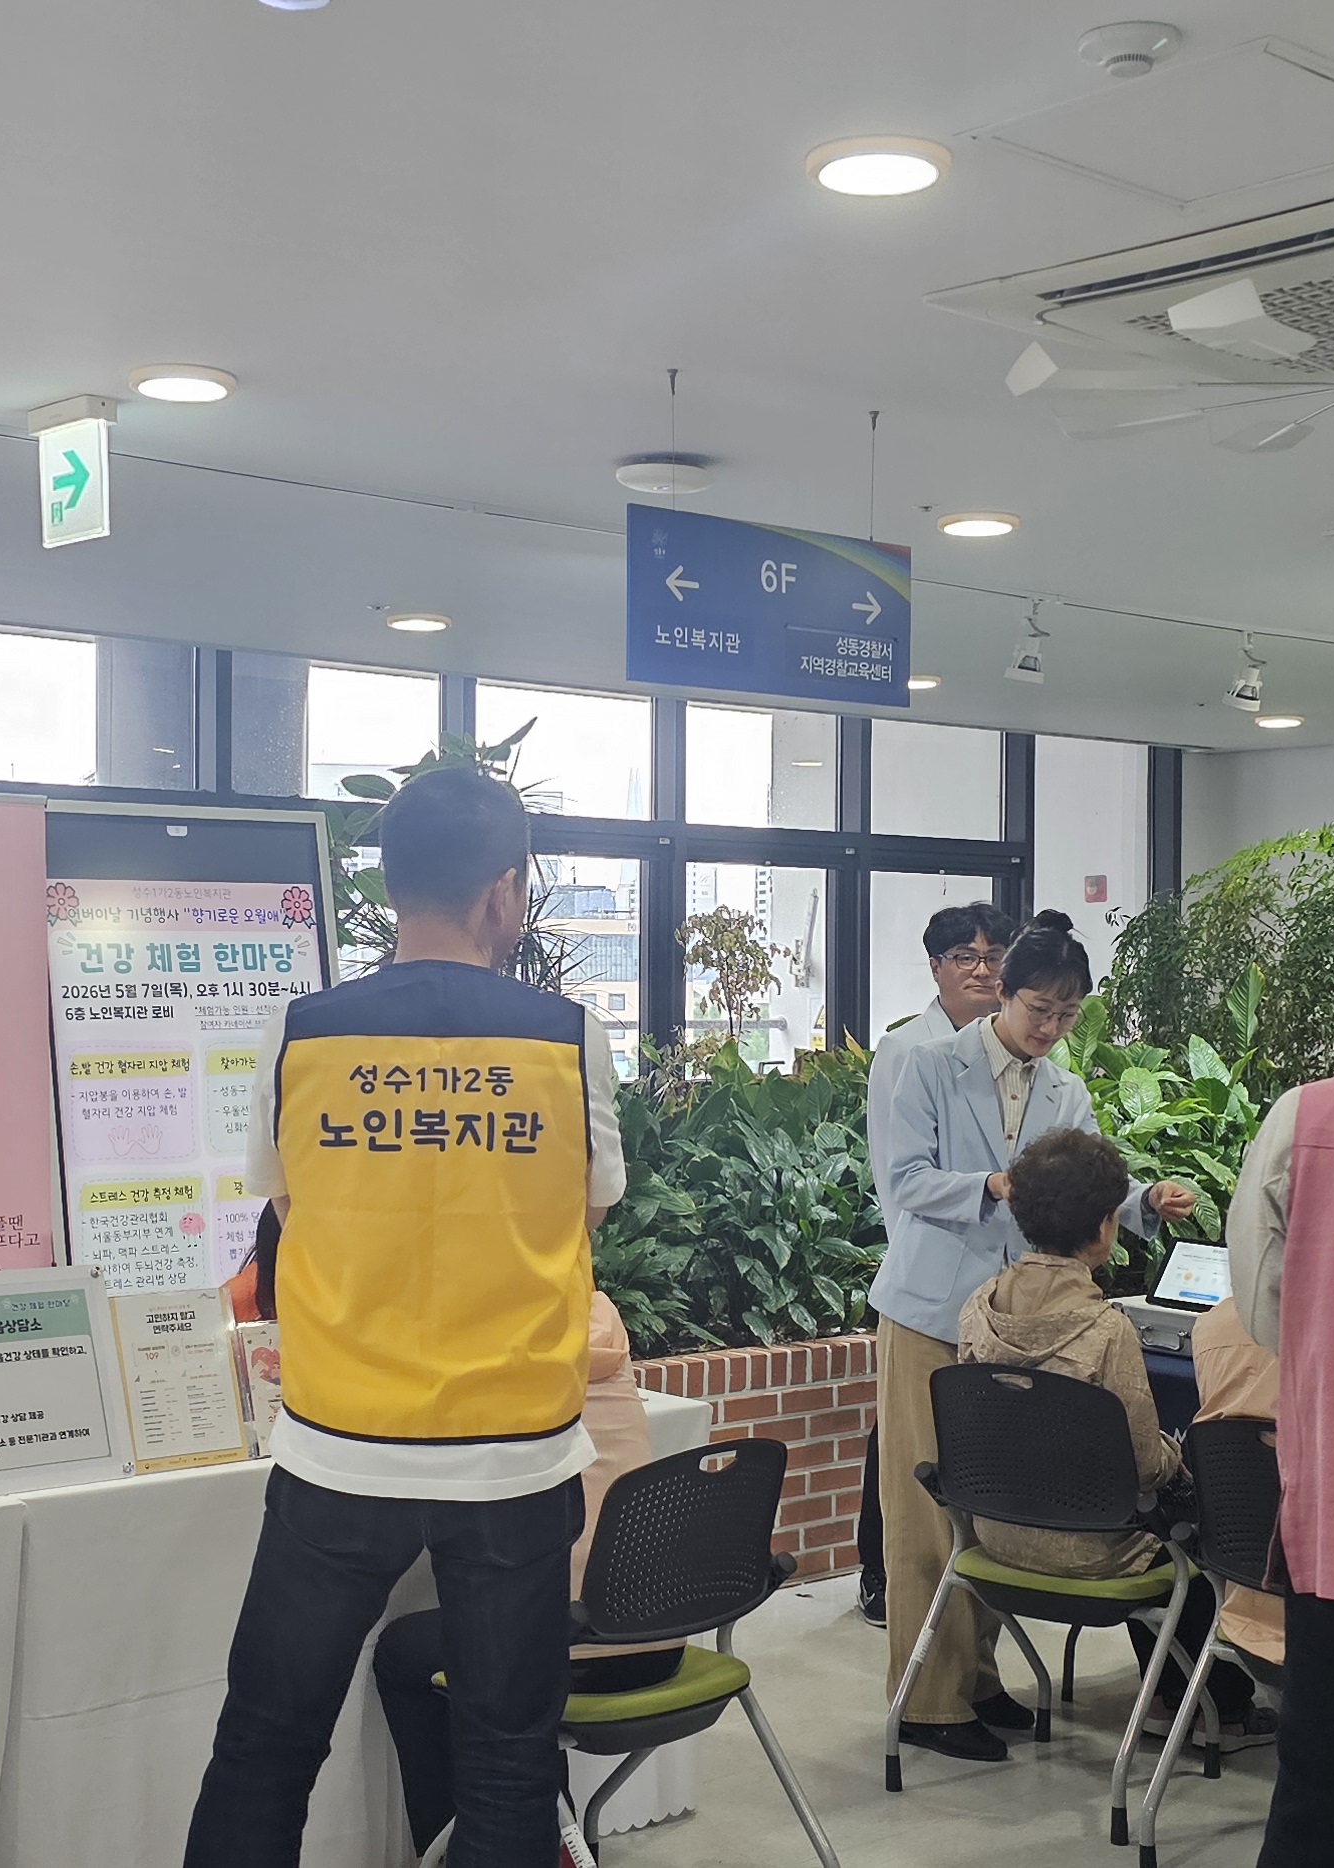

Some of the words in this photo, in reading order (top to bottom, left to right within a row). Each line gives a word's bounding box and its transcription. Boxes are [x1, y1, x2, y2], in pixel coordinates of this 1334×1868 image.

[759, 559, 798, 594] 6F
[655, 624, 741, 654] 노인복지관
[836, 636, 893, 661] 성동경찰서
[800, 655, 893, 683] 지역경찰교육센터
[133, 887, 232, 900] 성수1가2동노인복지관
[67, 907, 121, 923] 어버이날
[127, 908, 180, 925] 기념행사
[183, 908, 240, 924] "향기로운
[76, 943, 135, 974] 건강
[145, 942, 202, 973] 체험
[213, 942, 295, 973] 한마당
[61, 984, 112, 999] 2026년
[115, 984, 137, 999] 5월
[141, 982, 193, 1000] 7일(목),
[196, 983, 220, 998] 오후
[223, 981, 244, 997] 1시
[249, 981, 312, 998] 30분~4시
[65, 1006, 86, 1021] 6층
[89, 1006, 148, 1020] 노인복지관
[152, 1005, 174, 1019] 로비
[94, 1061, 114, 1074] 건강
[117, 1059, 146, 1073] 혈자리
[149, 1059, 168, 1072] 지압
[171, 1057, 191, 1072] 체험
[349, 1064, 514, 1097] 성수1가2동
[79, 1089, 118, 1103] 지압봉을
[121, 1088, 159, 1101] 이용하여
[220, 1084, 247, 1097] 성동구
[82, 1106, 111, 1120] 혈자리
[114, 1105, 134, 1118] 건강
[137, 1104, 156, 1117] 지압
[159, 1103, 178, 1116] 체험
[319, 1107, 544, 1154] 노인복지관
[90, 1191, 127, 1204] 스트레스
[131, 1189, 149, 1203] 건강
[153, 1187, 172, 1200] 측정
[174, 1185, 193, 1199] 체험
[89, 1212, 167, 1229] 한국건강관리협회
[154, 1226, 174, 1240] 연계
[141, 1243, 180, 1256] 스트레스
[103, 1262, 131, 1275] 사하여
[134, 1259, 173, 1272] 두뇌건강
[104, 1278, 133, 1290] 트레스
[136, 1274, 165, 1287] 관리법
[168, 1271, 187, 1285] 상담
